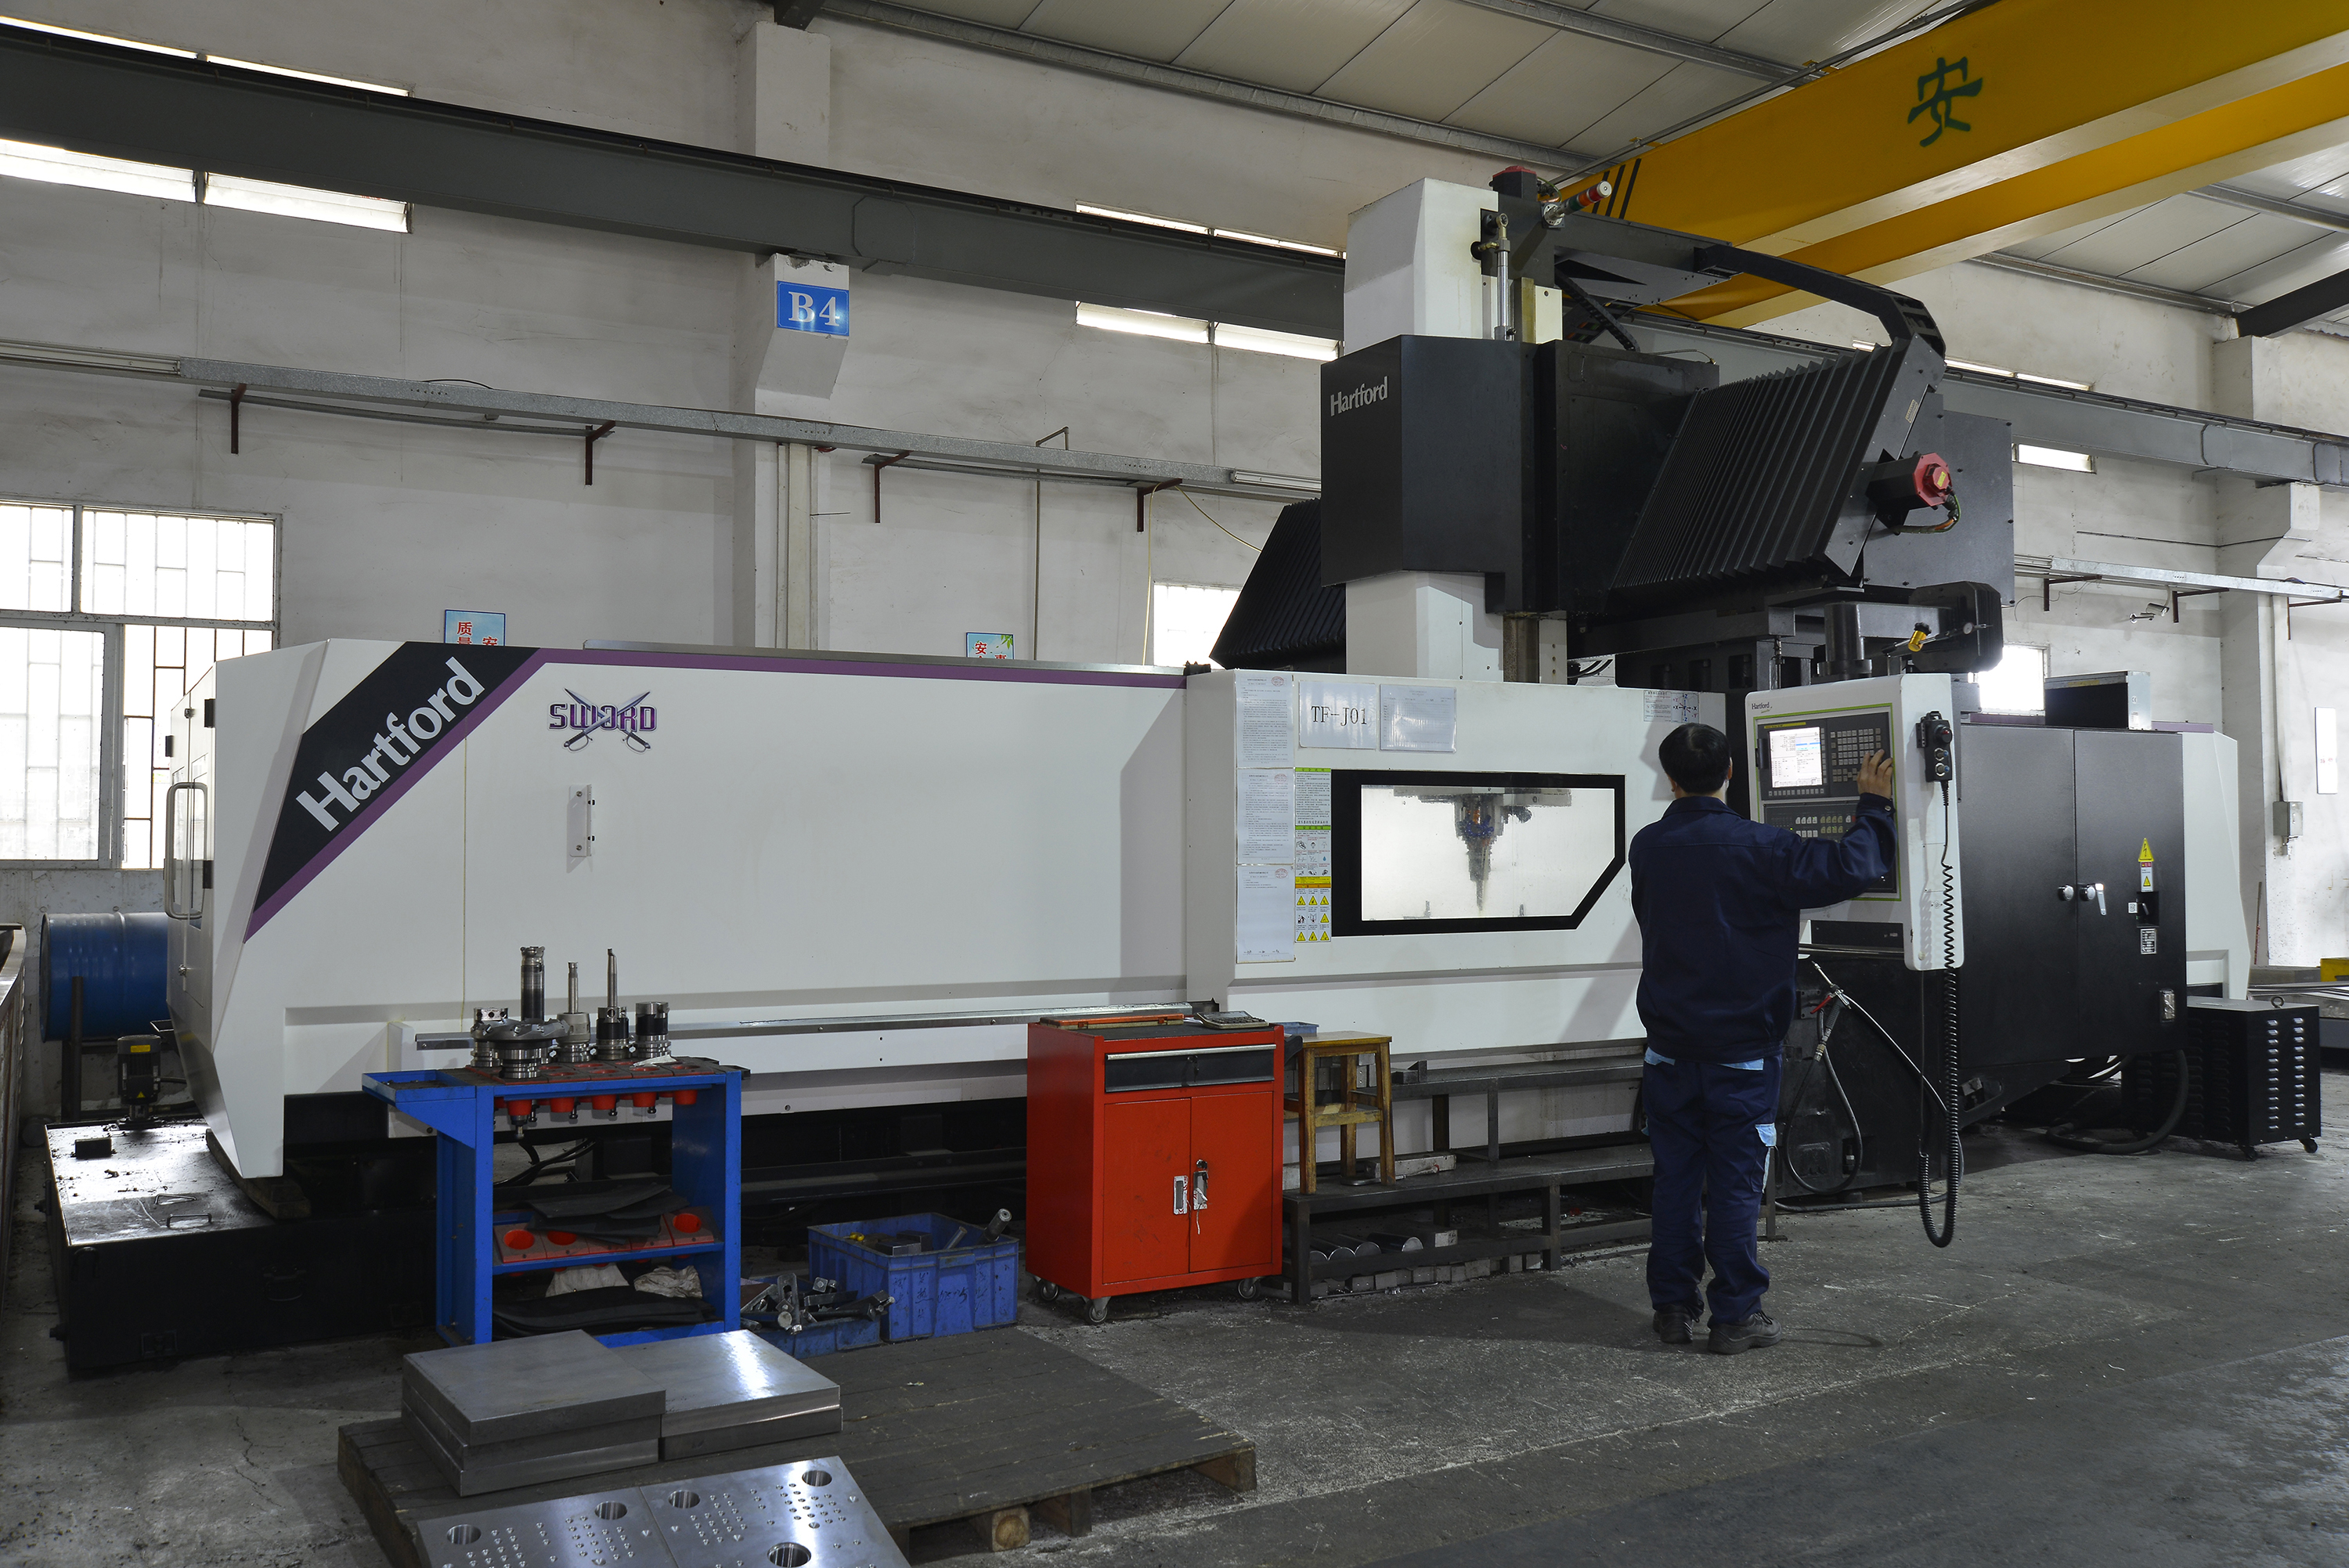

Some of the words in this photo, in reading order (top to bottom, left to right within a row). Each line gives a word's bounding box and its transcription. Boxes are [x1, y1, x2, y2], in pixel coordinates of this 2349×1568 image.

[1907, 56, 1983, 147] 安
[788, 291, 840, 326] B4
[1330, 376, 1389, 416] Hartford
[549, 703, 657, 732] SWORD
[1311, 705, 1367, 726] TF-J01
[1751, 701, 1770, 710] Hartford
[296, 656, 485, 832] Hartford
